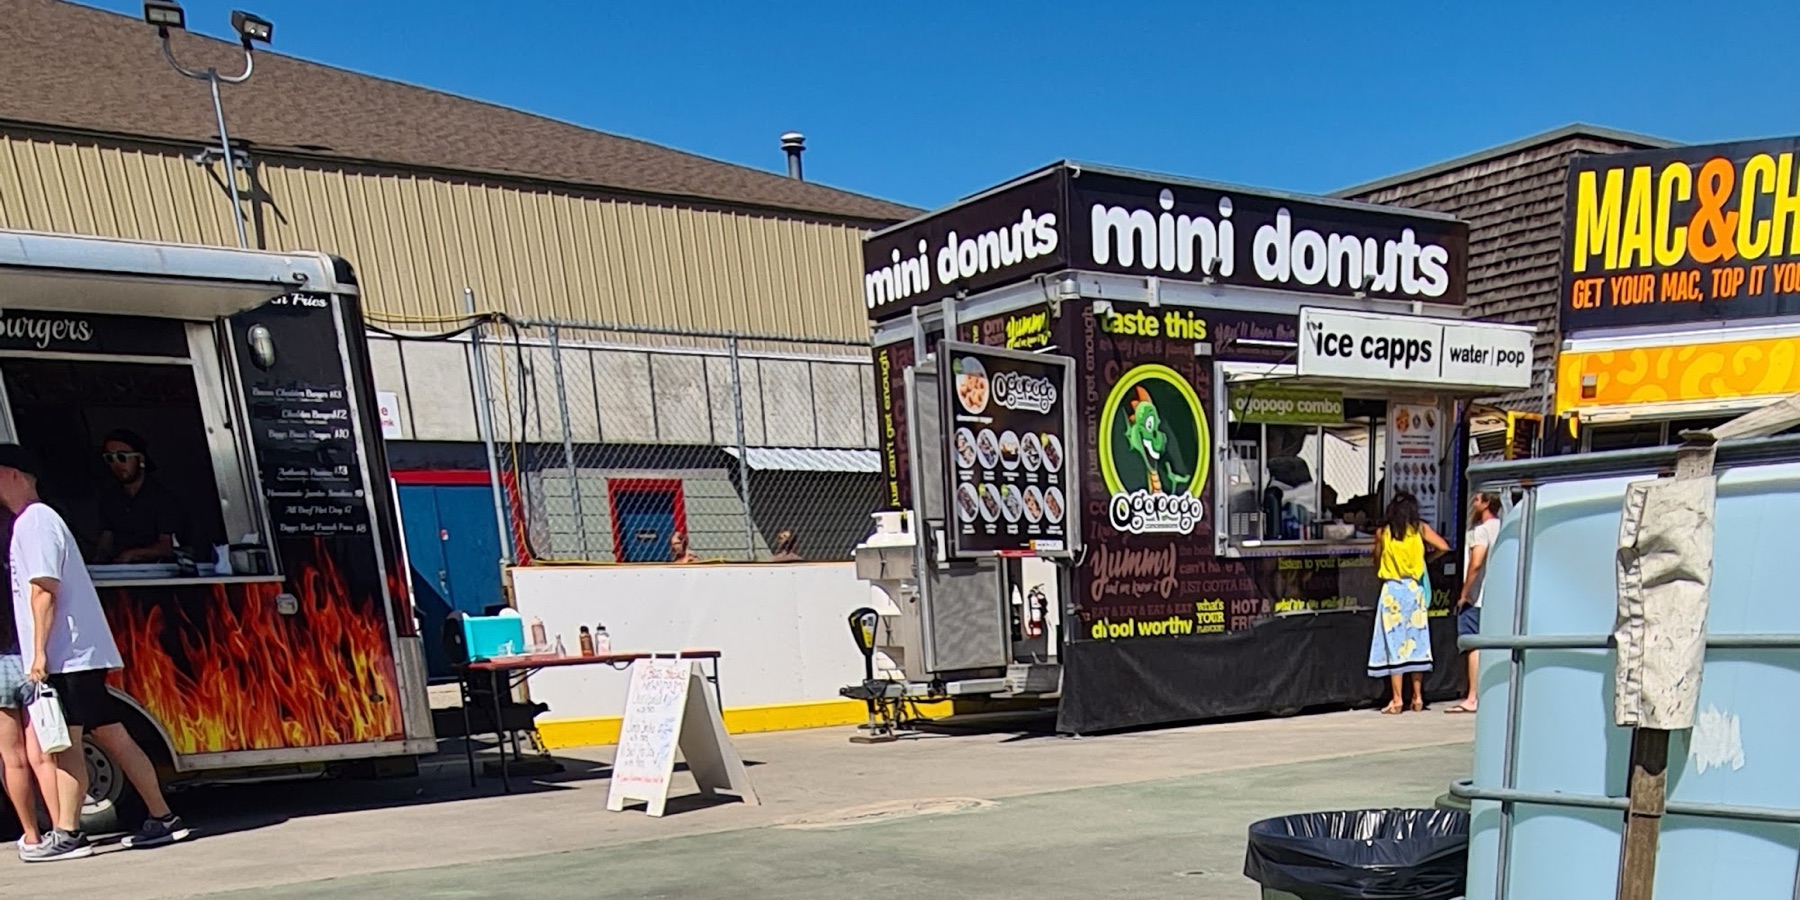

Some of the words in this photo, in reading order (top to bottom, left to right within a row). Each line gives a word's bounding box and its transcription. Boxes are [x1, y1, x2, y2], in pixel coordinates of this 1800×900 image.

[866, 239, 930, 309] mini
[937, 208, 1058, 285] donuts
[1092, 188, 1235, 277] mini
[1253, 207, 1449, 297] donuts
[1572, 278, 1605, 310] GET
[1611, 274, 1656, 307] YOUR
[1661, 269, 1704, 303] MAC,
[1712, 267, 1745, 299] TOP
[1749, 265, 1767, 296] IT
[1081, 306, 1097, 372] enough
[1101, 308, 1160, 337] taste
[1164, 310, 1207, 340] this
[1315, 322, 1354, 358] ice
[1360, 335, 1433, 370] capps
[1449, 345, 1488, 364] water
[1496, 350, 1526, 368] pop
[878, 349, 892, 411] enough
[882, 412, 895, 440] get
[1236, 397, 1294, 415] ogopogo
[1297, 397, 1342, 413] combo
[1111, 490, 1202, 533] Ogopogo
[1207, 560, 1234, 574] hae
[1196, 611, 1225, 624] YOUR
[1231, 599, 1259, 614] HOT
[1261, 598, 1271, 613] &
